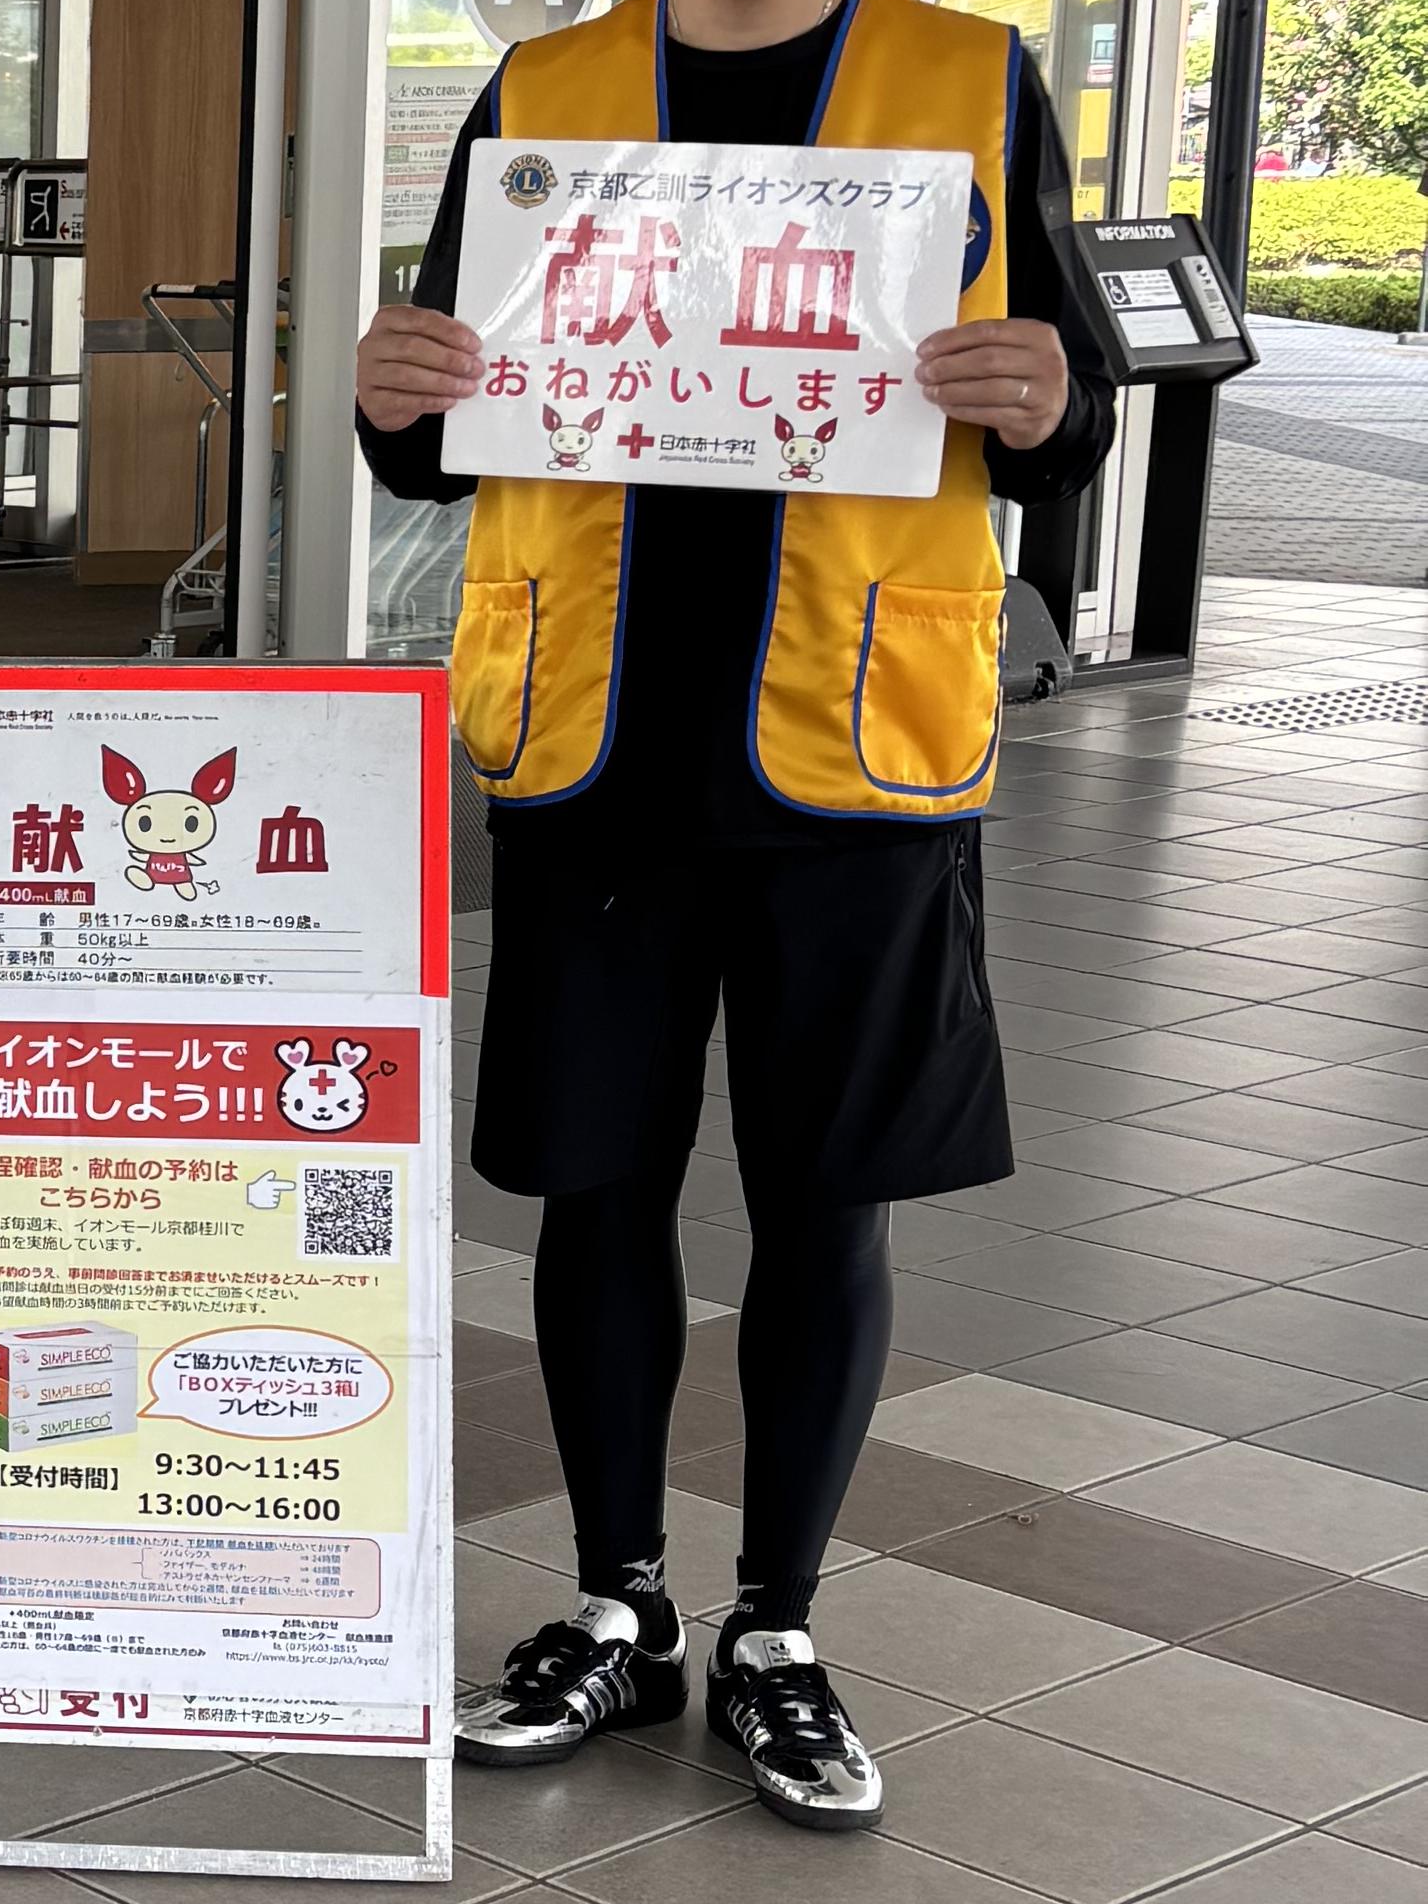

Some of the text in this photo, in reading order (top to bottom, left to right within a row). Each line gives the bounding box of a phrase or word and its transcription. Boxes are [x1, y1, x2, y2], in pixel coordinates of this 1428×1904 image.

[568, 169, 930, 211] 京都乙訓ライオンズクラブ
[1095, 225, 1175, 241] INFORMATION
[486, 354, 903, 416] おねがいします
[77, 932, 150, 948] 50kg以上
[40, 1186, 162, 1210] こちらから
[173, 1352, 363, 1375] ご協力いただいた方に
[219, 1398, 318, 1418] プレゼント!!!
[0, 1464, 120, 1492] 【受付時間】
[183, 1707, 345, 1724] 京都府赤十字血液センター
